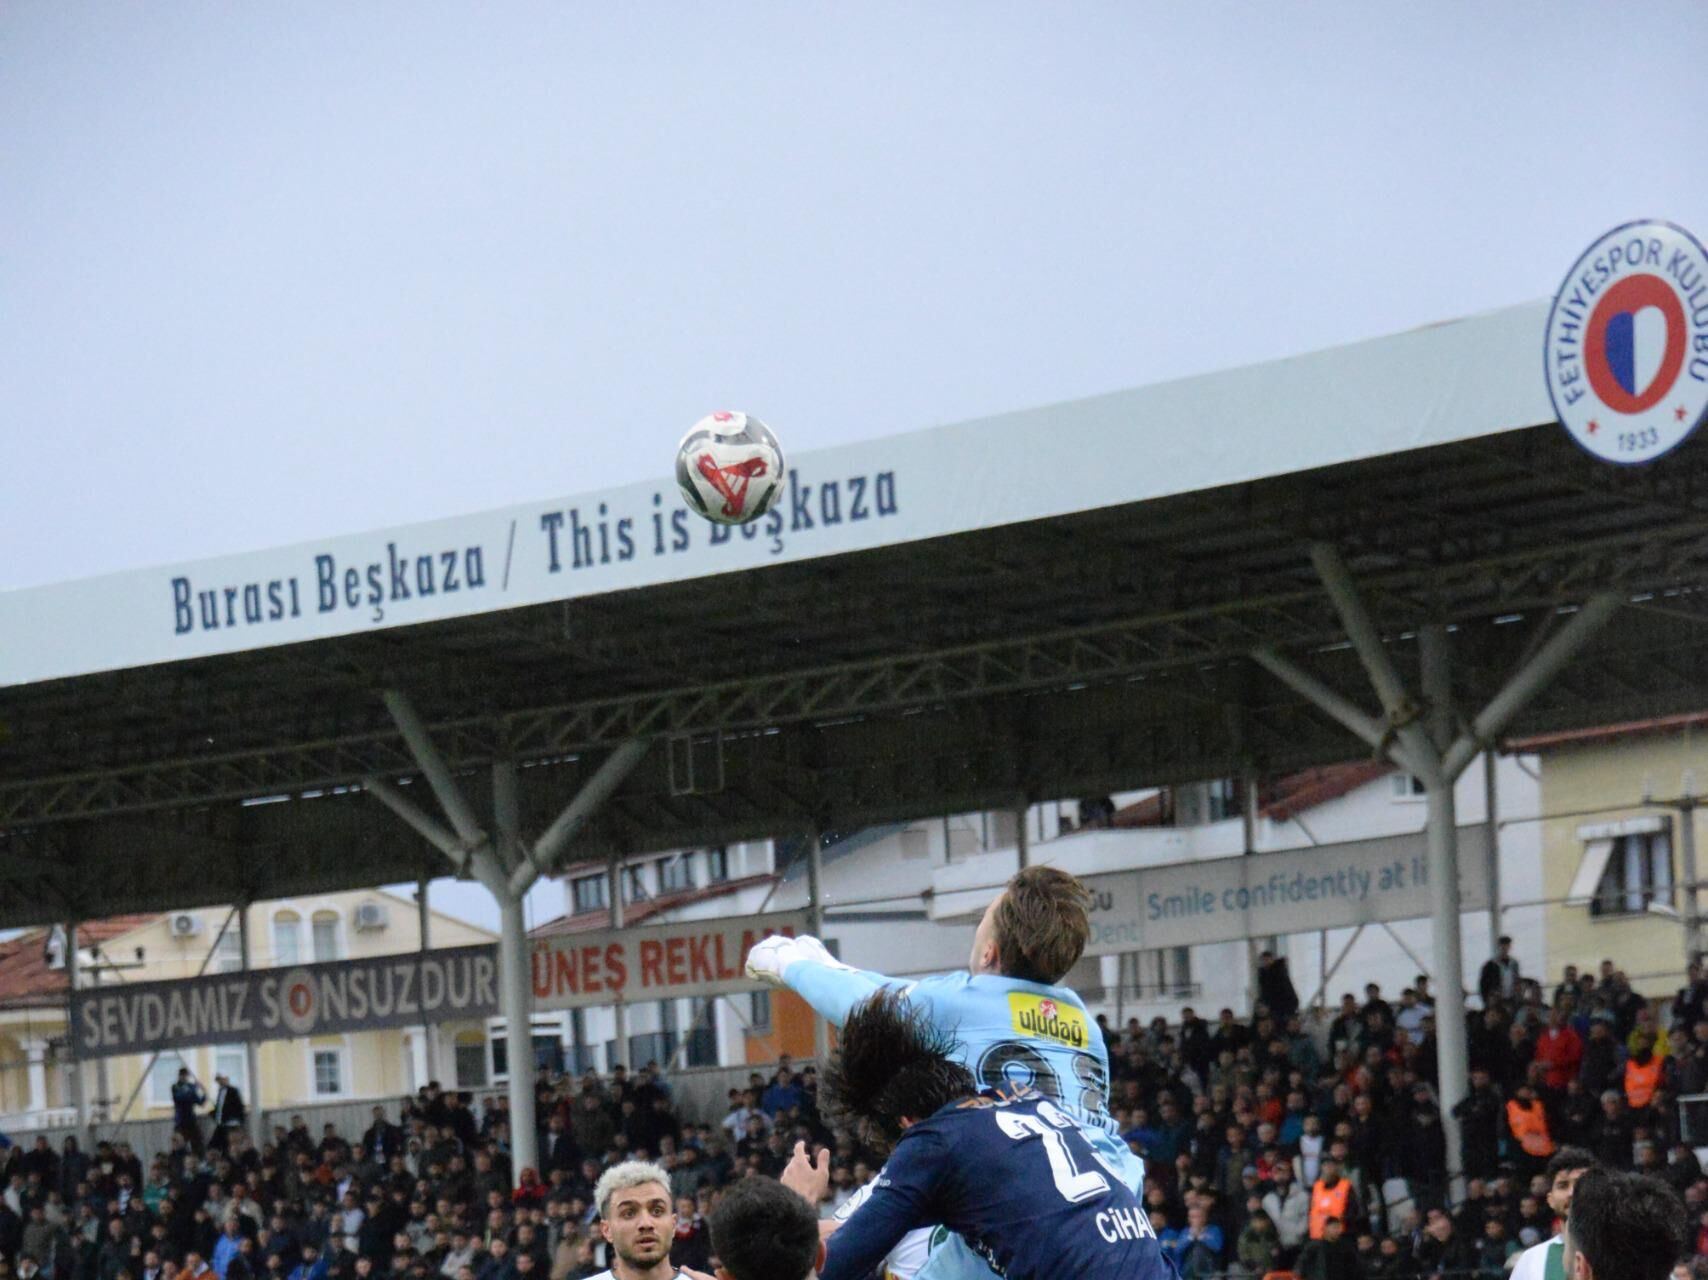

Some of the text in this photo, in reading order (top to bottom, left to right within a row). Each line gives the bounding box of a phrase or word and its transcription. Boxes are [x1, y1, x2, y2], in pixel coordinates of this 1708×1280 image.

[1618, 428, 1659, 452] 1933
[171, 576, 302, 636] Burası
[315, 542, 486, 623] Beşkaza
[541, 506, 635, 575] This
[653, 491, 691, 554] is
[1148, 886, 1216, 920] Smile
[1222, 864, 1371, 912] confidently
[1378, 861, 1406, 890] at
[531, 925, 795, 1002] ÜNEŞ REKLA
[82, 983, 252, 1048] SEVDAMIZ
[1018, 1008, 1083, 1048] uludağ
